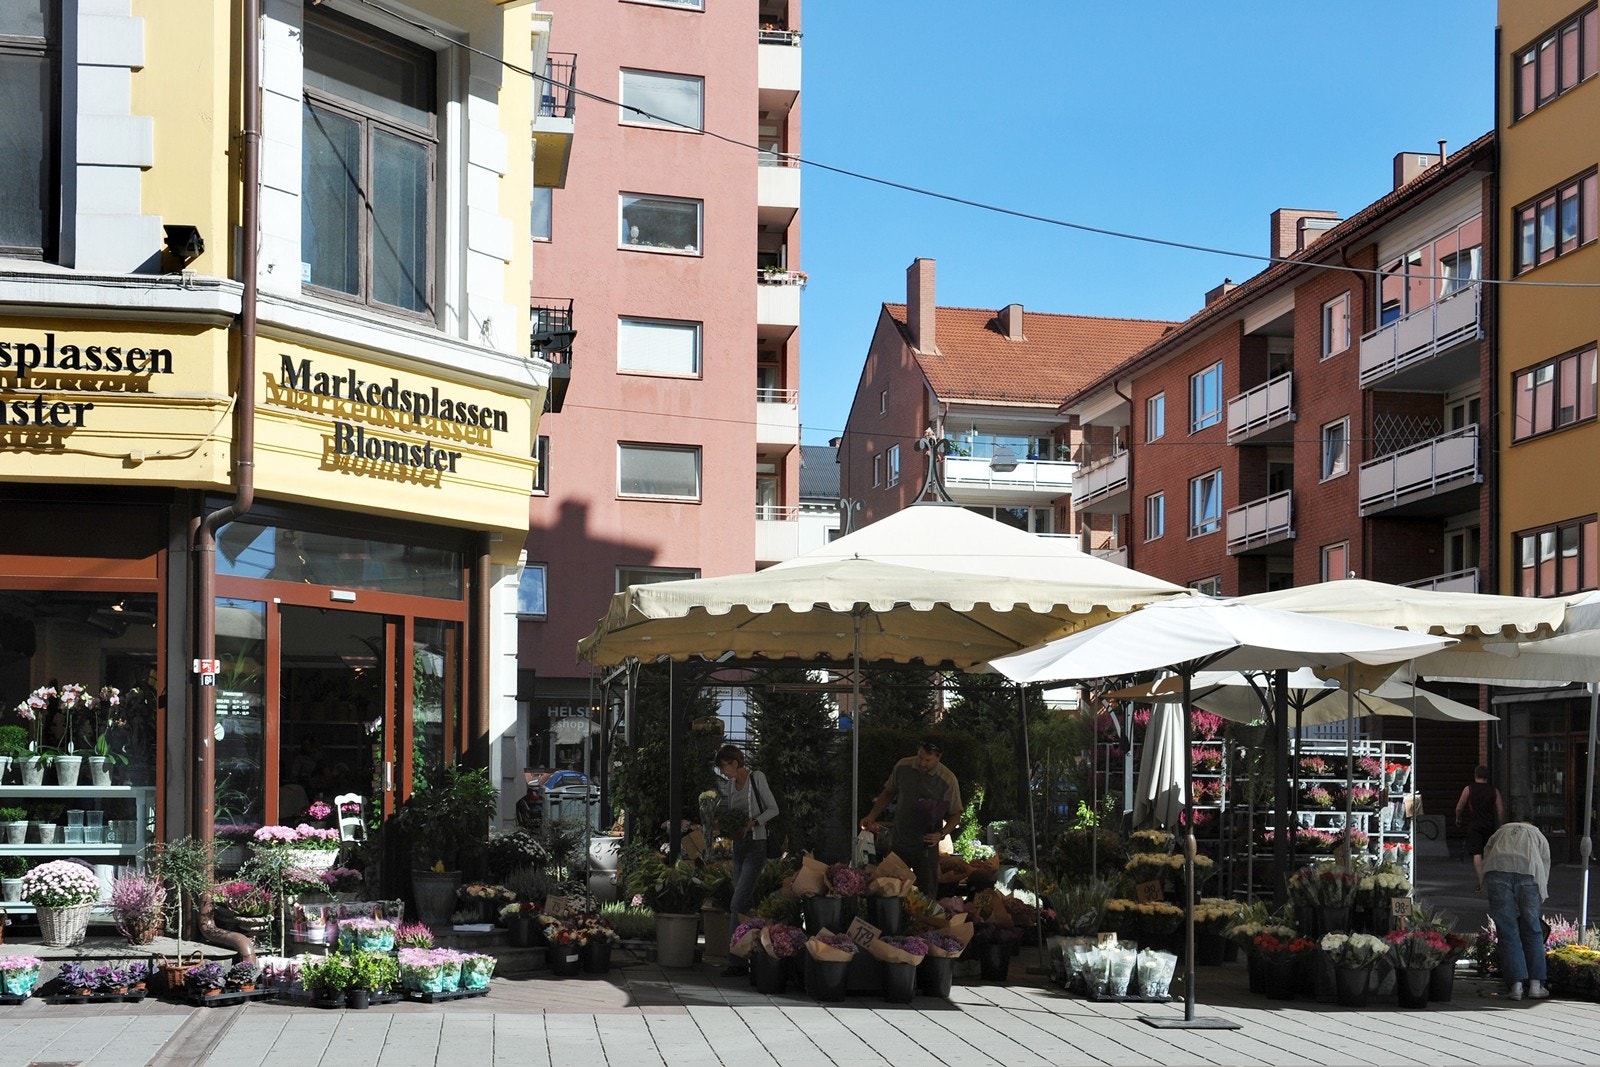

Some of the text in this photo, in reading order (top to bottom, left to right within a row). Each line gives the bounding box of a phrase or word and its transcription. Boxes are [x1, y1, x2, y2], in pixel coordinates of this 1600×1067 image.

[279, 354, 508, 432] Markedsplassen
[332, 421, 462, 473] Blomster
[557, 719, 584, 731] shop
